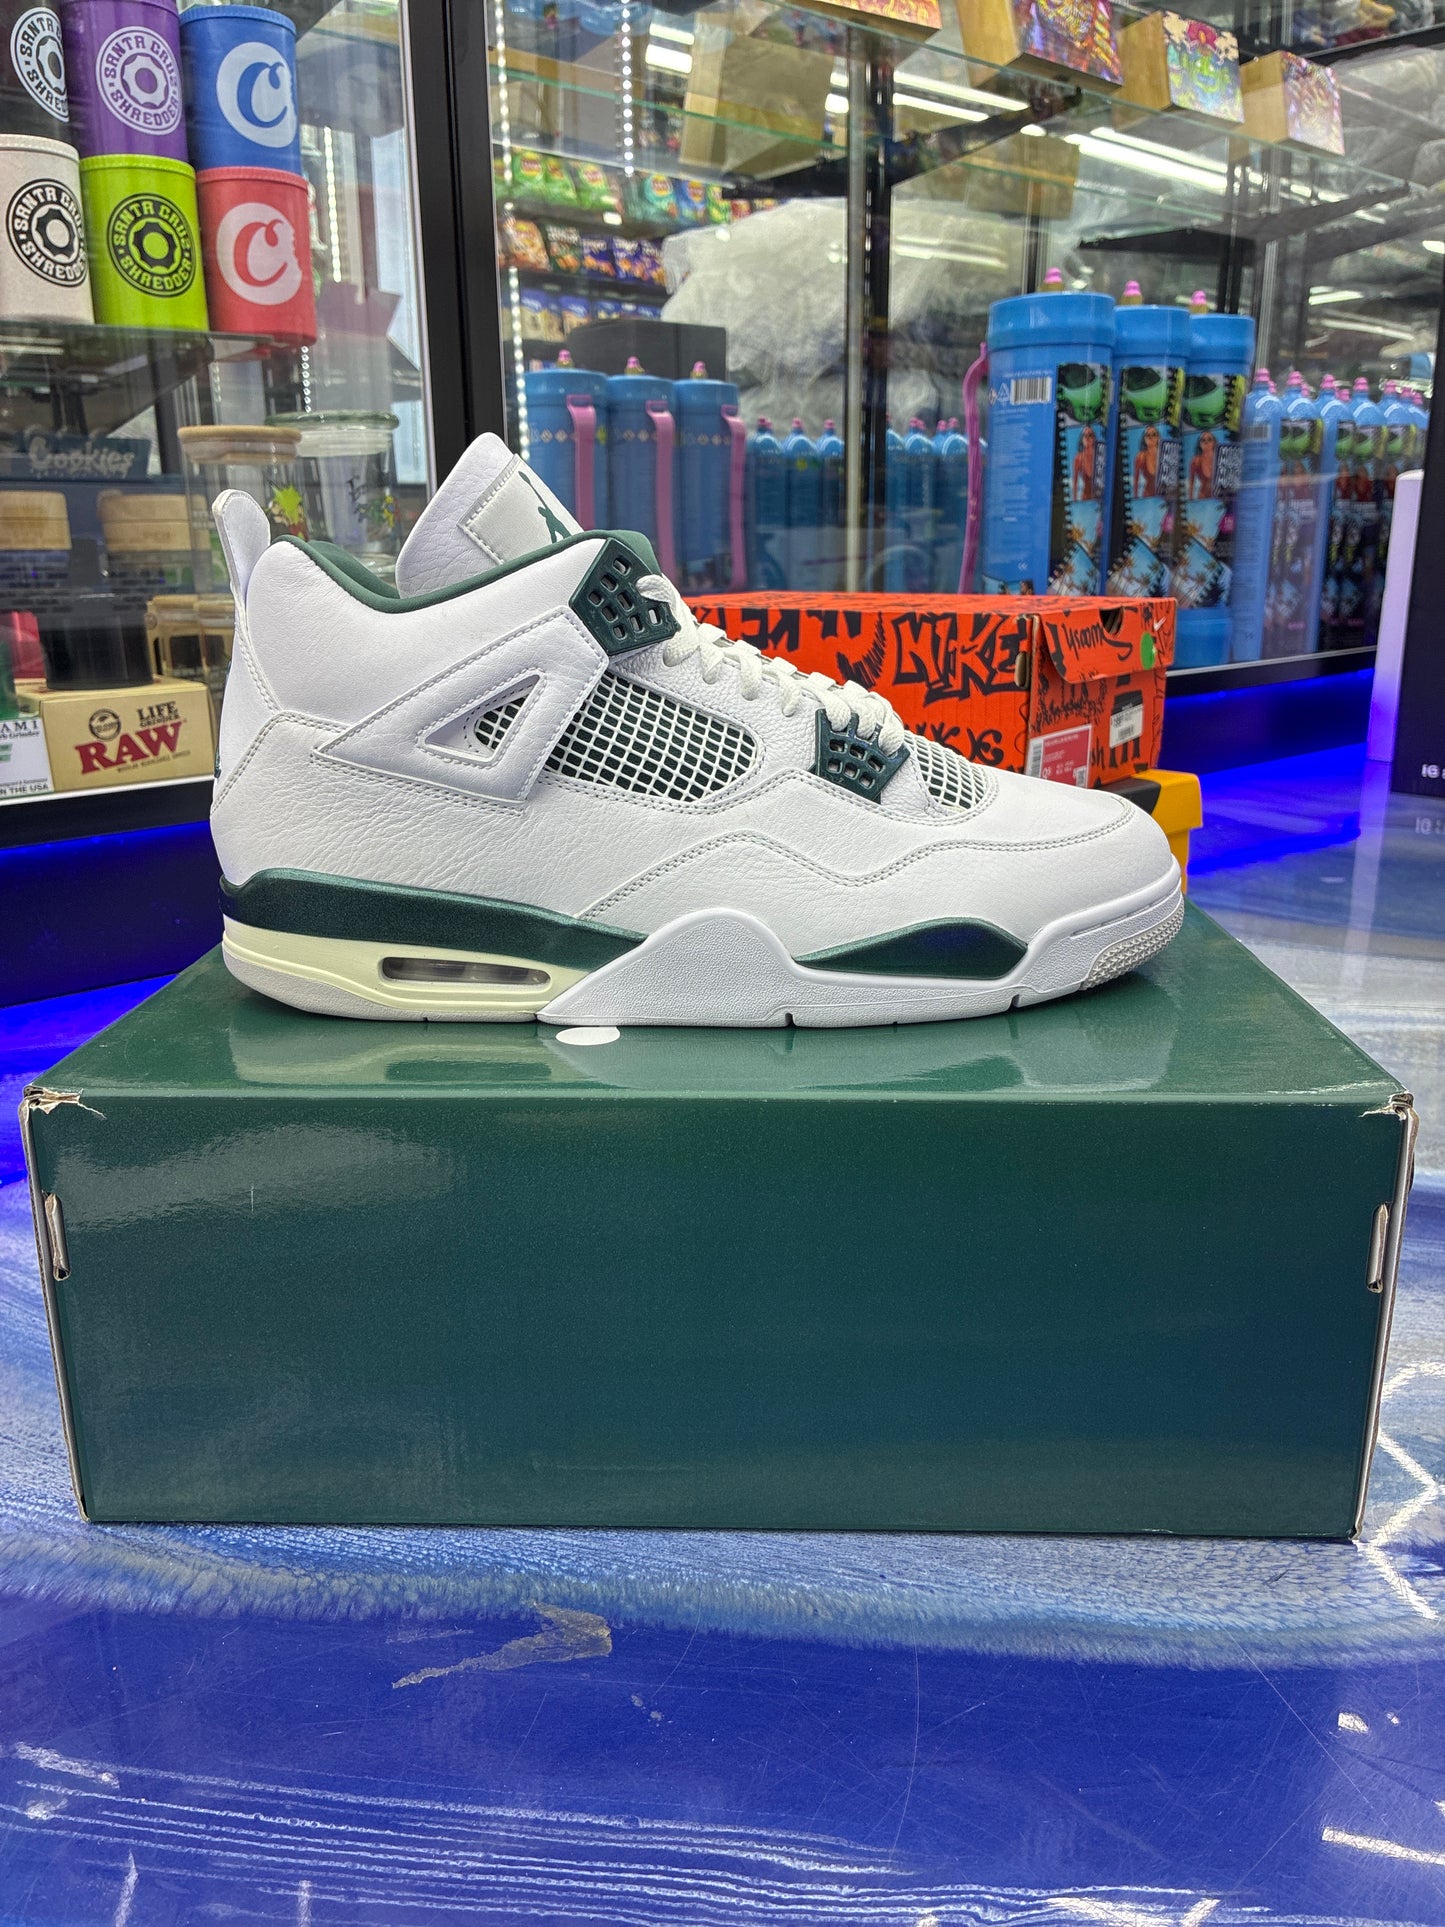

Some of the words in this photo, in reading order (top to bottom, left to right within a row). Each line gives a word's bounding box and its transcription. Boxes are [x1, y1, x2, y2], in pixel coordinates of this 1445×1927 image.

[20, 17, 54, 58] SANTA
[104, 35, 147, 79] SANTA
[150, 40, 178, 87] CRUZ
[110, 89, 179, 127] SHREDDER
[14, 186, 58, 232] SANTA
[113, 200, 155, 246] SANTA
[158, 204, 191, 250] CRUZ
[120, 254, 192, 290] SHREDDER
[29, 436, 136, 479] Cookies
[137, 701, 178, 721] LIFE
[74, 721, 183, 775] RAW
[29, 782, 49, 792] USA
